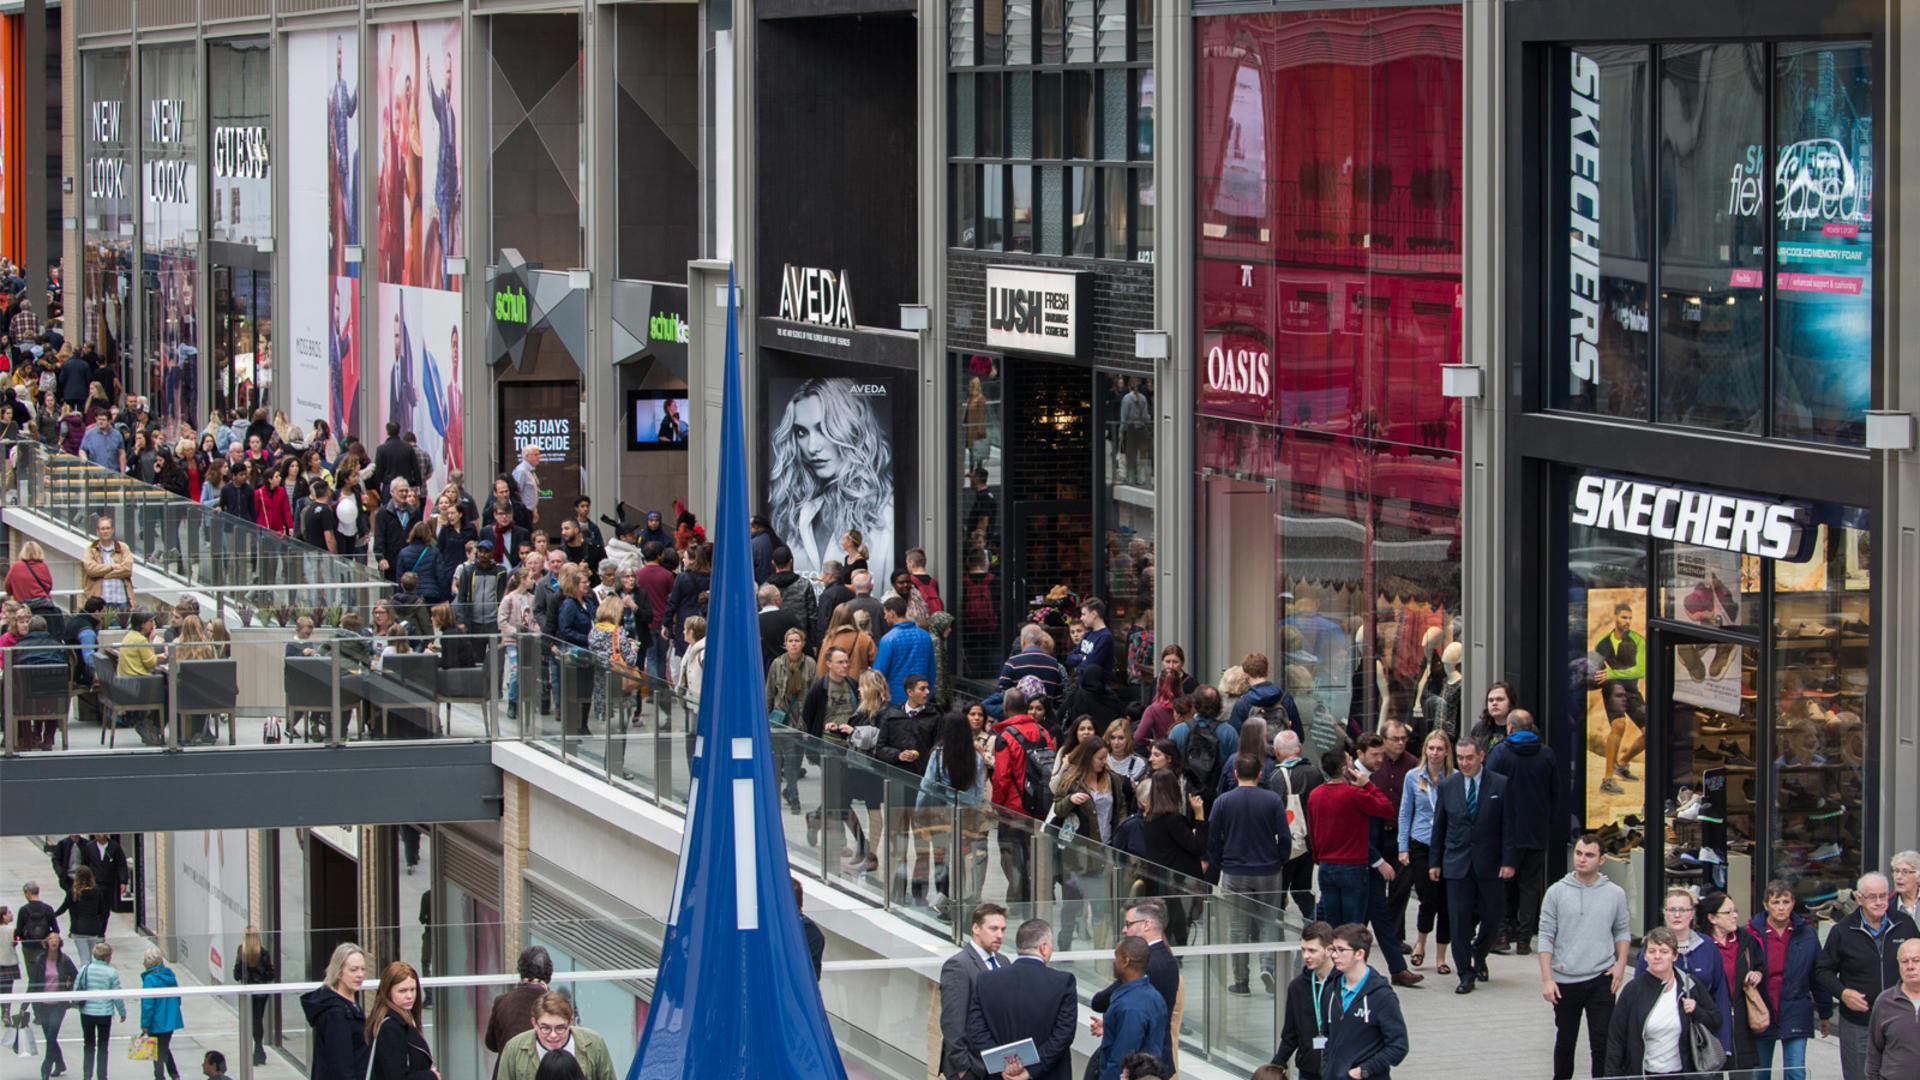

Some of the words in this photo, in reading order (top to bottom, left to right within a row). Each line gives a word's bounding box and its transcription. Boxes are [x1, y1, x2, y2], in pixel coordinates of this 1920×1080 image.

[92, 101, 121, 142] NEW
[151, 99, 183, 143] NEW
[214, 127, 268, 178] GUESS
[90, 158, 124, 199] LOOK
[150, 160, 187, 203] LOOK
[1570, 51, 1600, 385] SKECHERS
[495, 285, 527, 323] schuh
[779, 263, 855, 328] AVEDA
[990, 286, 1042, 335] LUSH
[1045, 292, 1069, 311] FRESH
[850, 384, 886, 393] AVEDA
[1208, 346, 1270, 397] OASIS
[515, 420, 537, 434] 365
[539, 419, 569, 434] DAYS
[1572, 475, 1796, 560] SKECHERS
